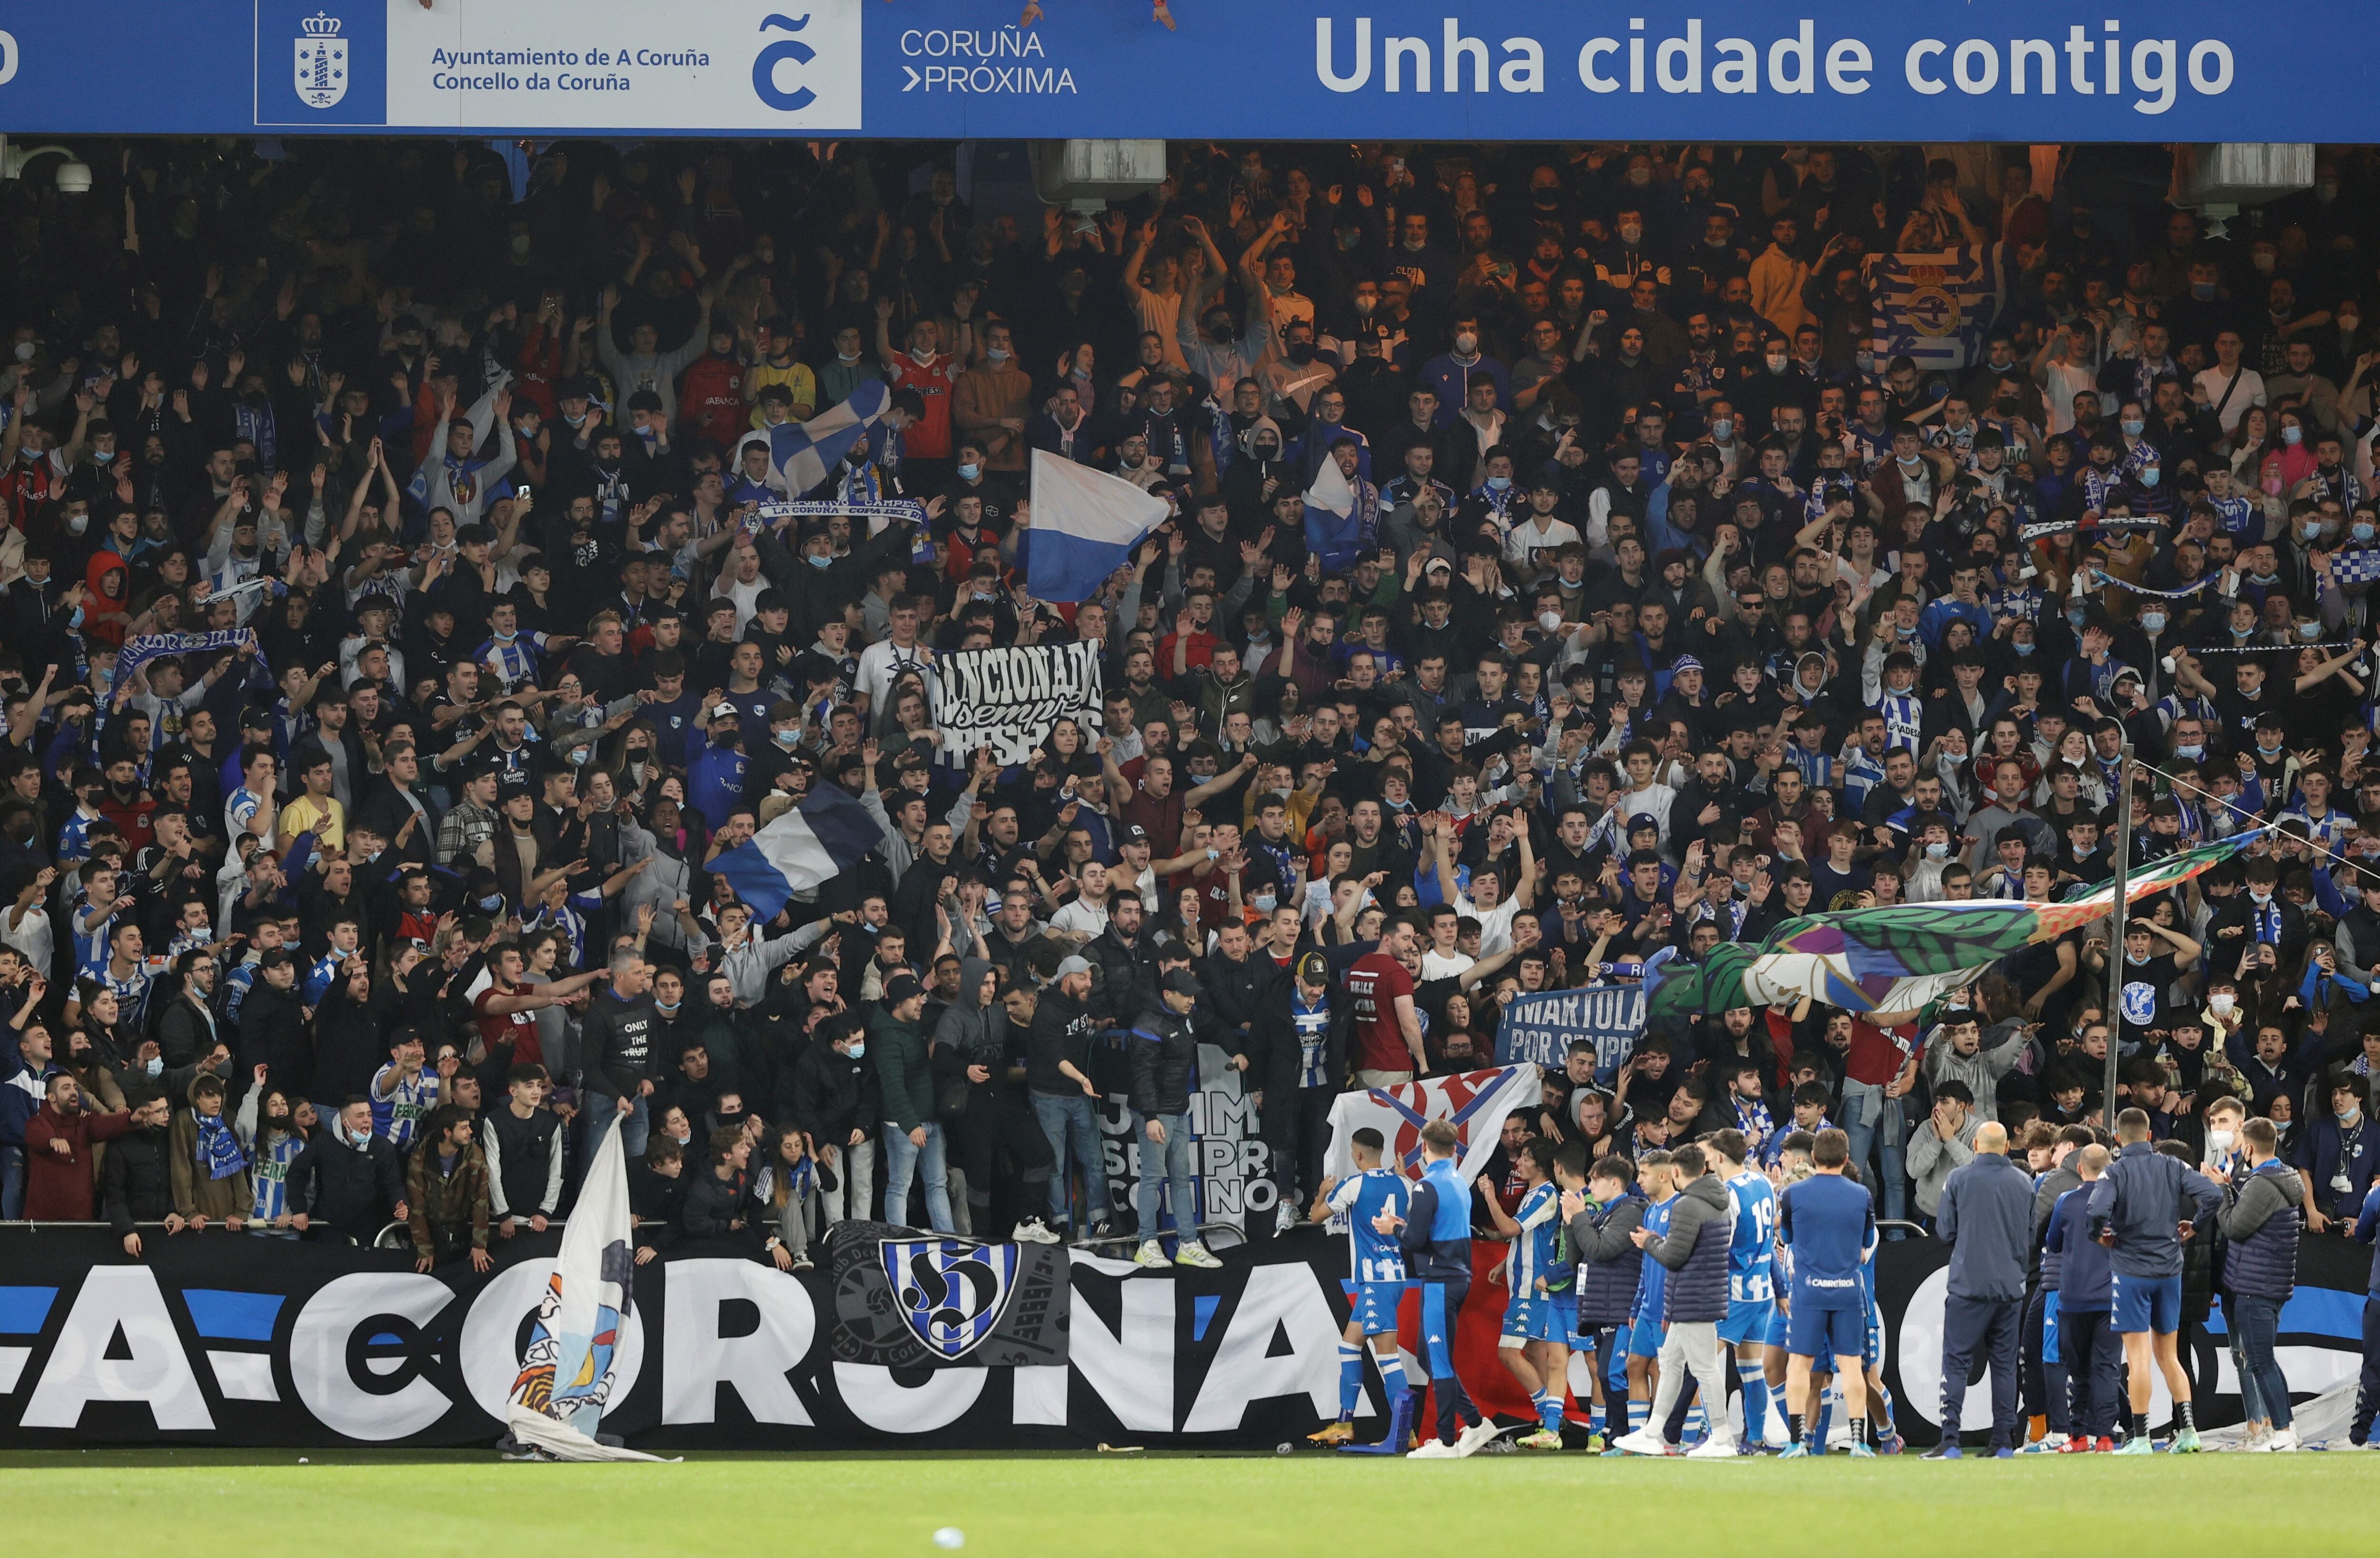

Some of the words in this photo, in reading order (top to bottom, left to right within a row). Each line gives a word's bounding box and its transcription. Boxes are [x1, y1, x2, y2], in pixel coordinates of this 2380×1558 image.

[901, 25, 1044, 58] CORUÑA
[432, 48, 578, 71] Ayuntamiento
[585, 48, 609, 66] de
[616, 50, 631, 66] A
[637, 50, 709, 66] Coruña
[1317, 18, 1543, 93] Unha
[1579, 18, 1872, 94] cidade
[1905, 20, 2233, 114] contigo
[433, 72, 519, 90] Concello
[526, 72, 549, 90] da
[558, 74, 629, 90] Coruña
[925, 59, 1077, 94] PRÓXIMA
[908, 511, 923, 520] RE
[208, 627, 250, 647] BLU
[956, 690, 1082, 733] sempre
[625, 1020, 648, 1033] ONLY
[631, 1034, 647, 1045] THE
[1509, 1028, 1552, 1064] POR
[1558, 1030, 1635, 1068] SMPR
[1380, 1193, 1396, 1219] 4
[1752, 1197, 1772, 1243] 19
[19, 1264, 216, 1430] A
[887, 1338, 923, 1363] Coru
